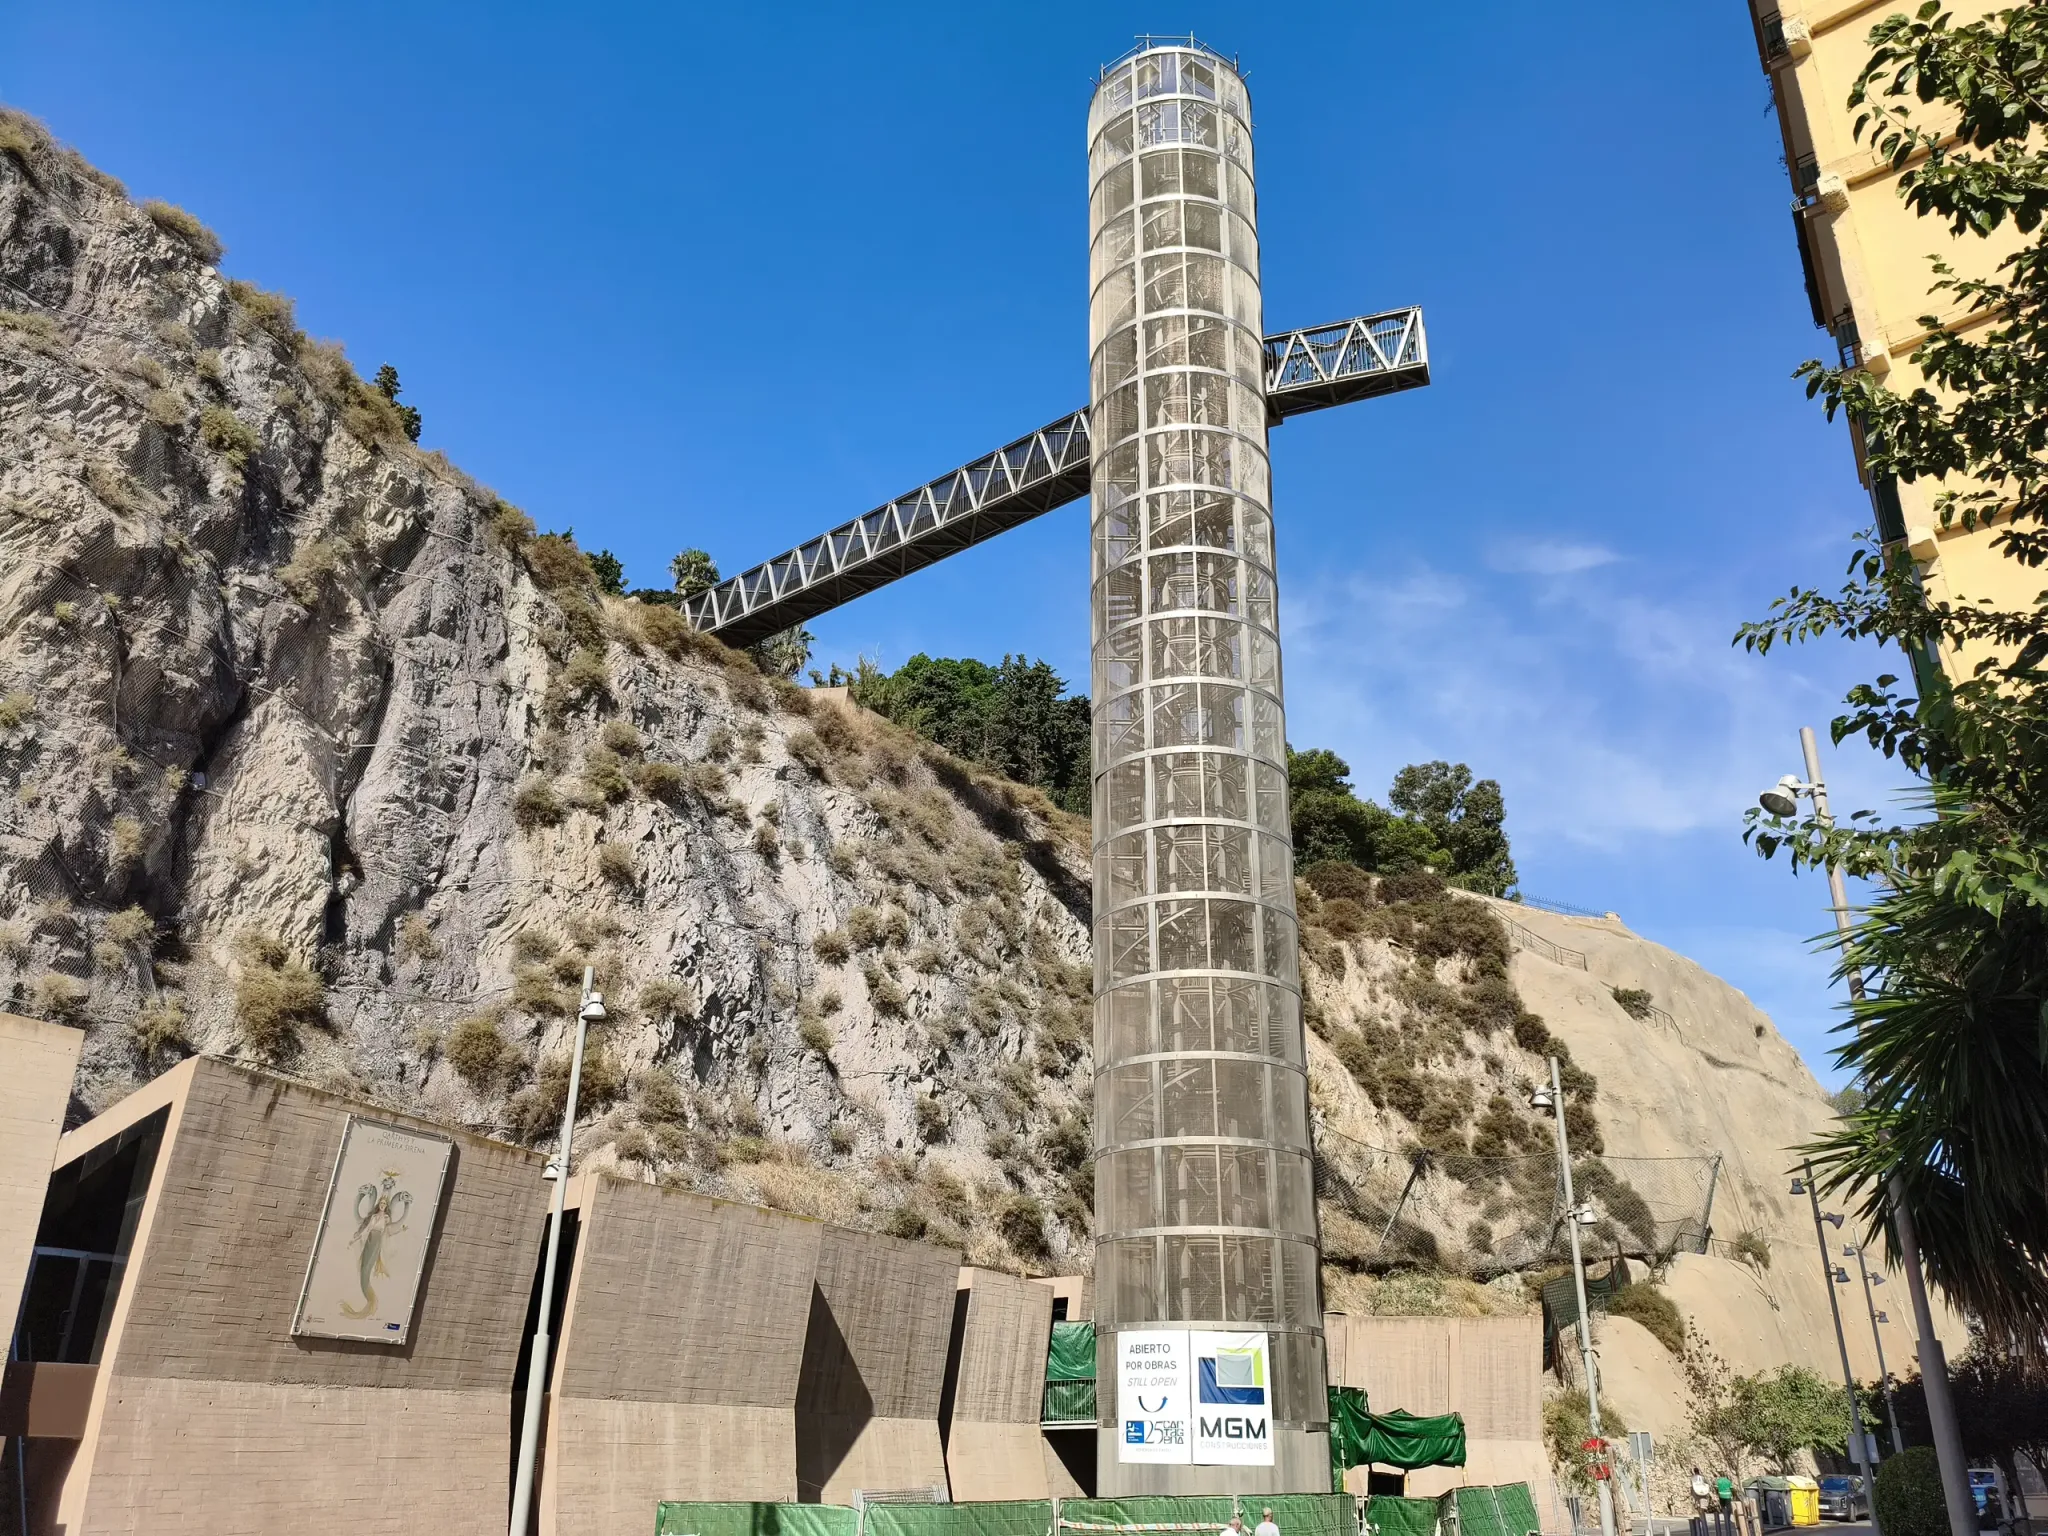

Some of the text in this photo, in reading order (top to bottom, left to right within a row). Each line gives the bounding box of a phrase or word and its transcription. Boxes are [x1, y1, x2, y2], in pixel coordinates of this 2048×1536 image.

[376, 1138, 403, 1149] PRIMERA
[404, 1144, 426, 1154] SIRENA
[1129, 1343, 1171, 1354] ABIERTO
[1125, 1360, 1177, 1370] POR OBRAS
[1127, 1377, 1178, 1387] STILL OPEN
[1200, 1416, 1267, 1439] MGM
[1200, 1440, 1268, 1450] CONSTRUCCIONES
